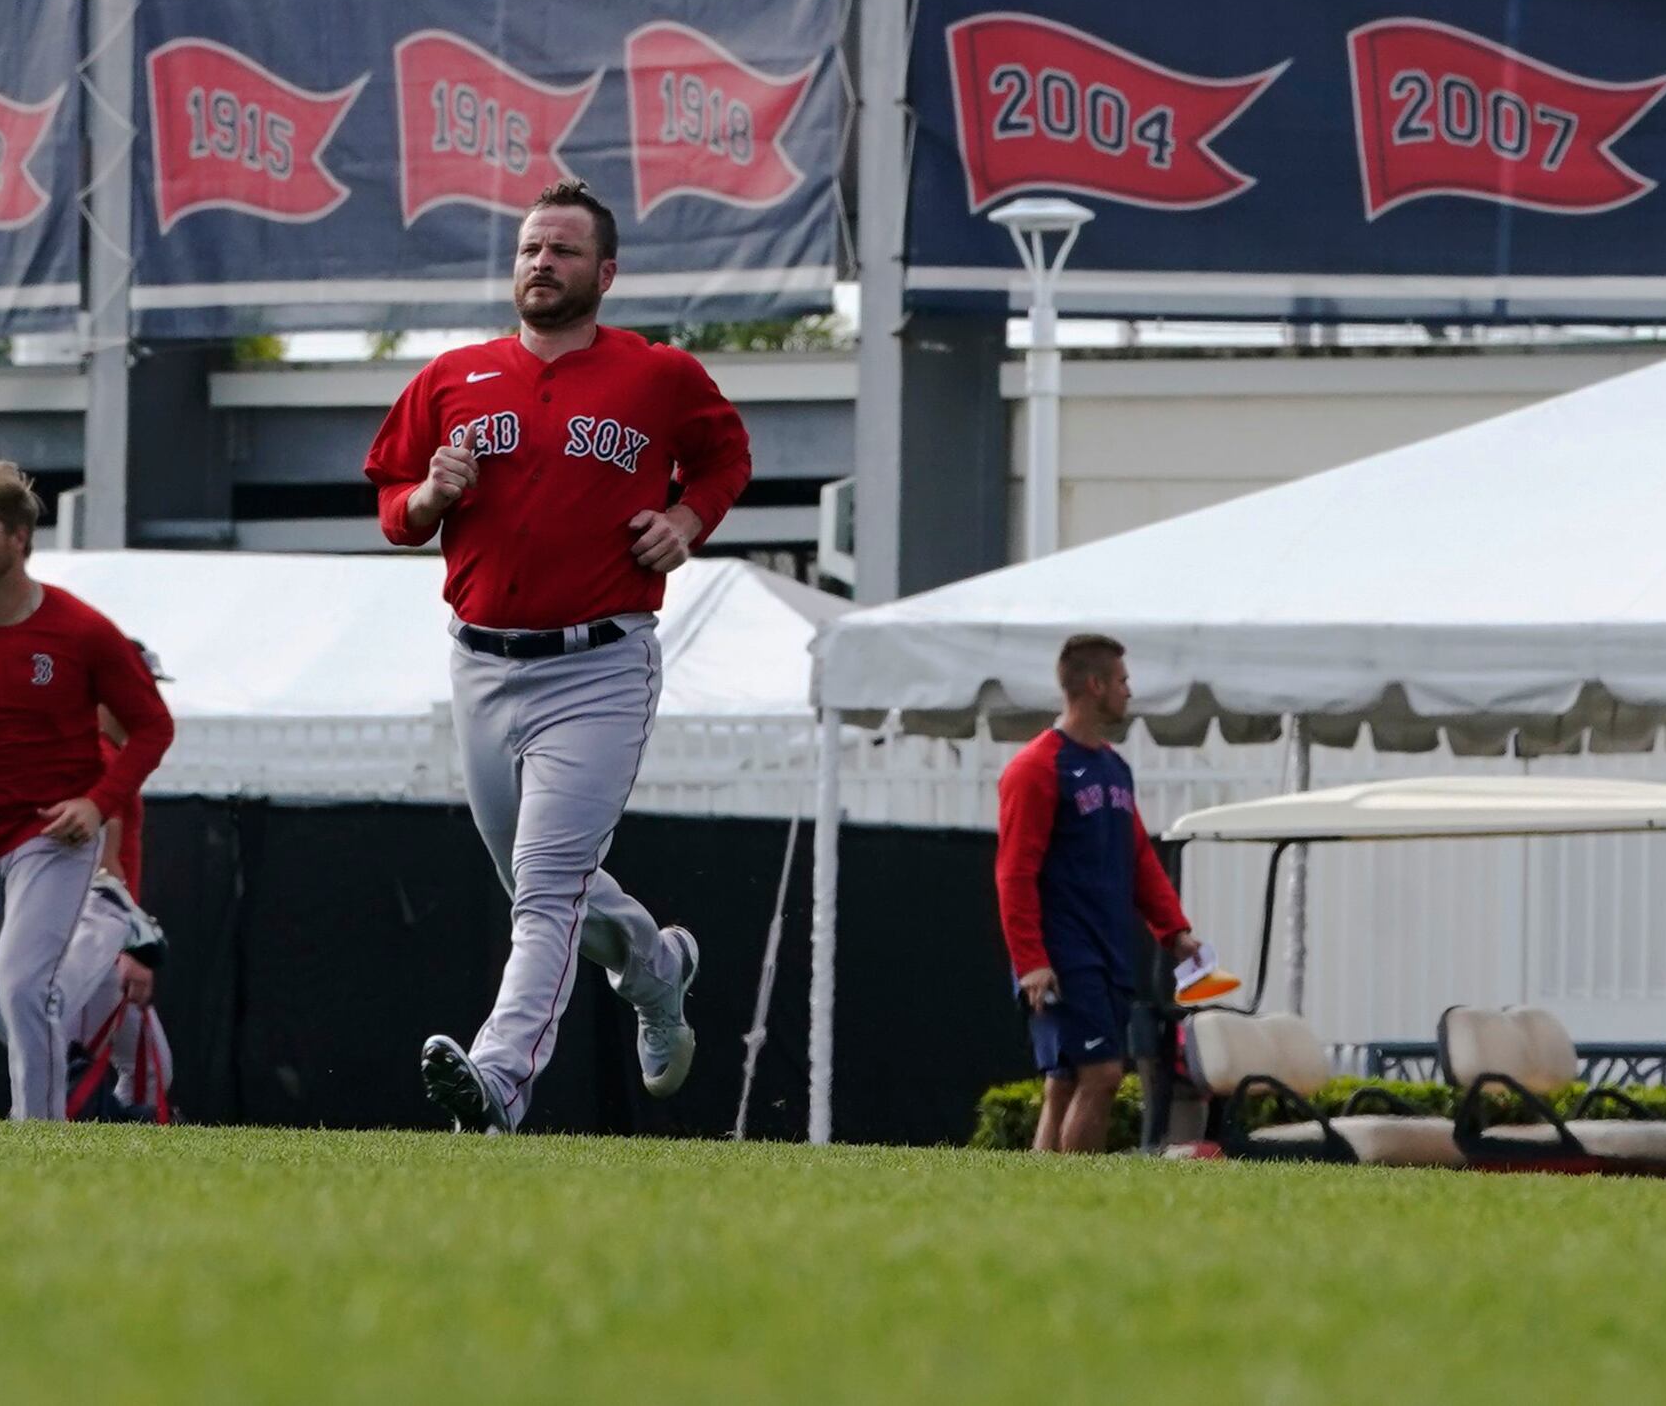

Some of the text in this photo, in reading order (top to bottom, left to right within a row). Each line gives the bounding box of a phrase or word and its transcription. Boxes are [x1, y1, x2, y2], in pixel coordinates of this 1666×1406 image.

[185, 85, 294, 181] 1915
[431, 79, 531, 175] 1916
[658, 70, 752, 167] 1918
[989, 63, 1175, 169] 2004
[1389, 69, 1578, 172] 2007
[564, 415, 650, 473] SOX
